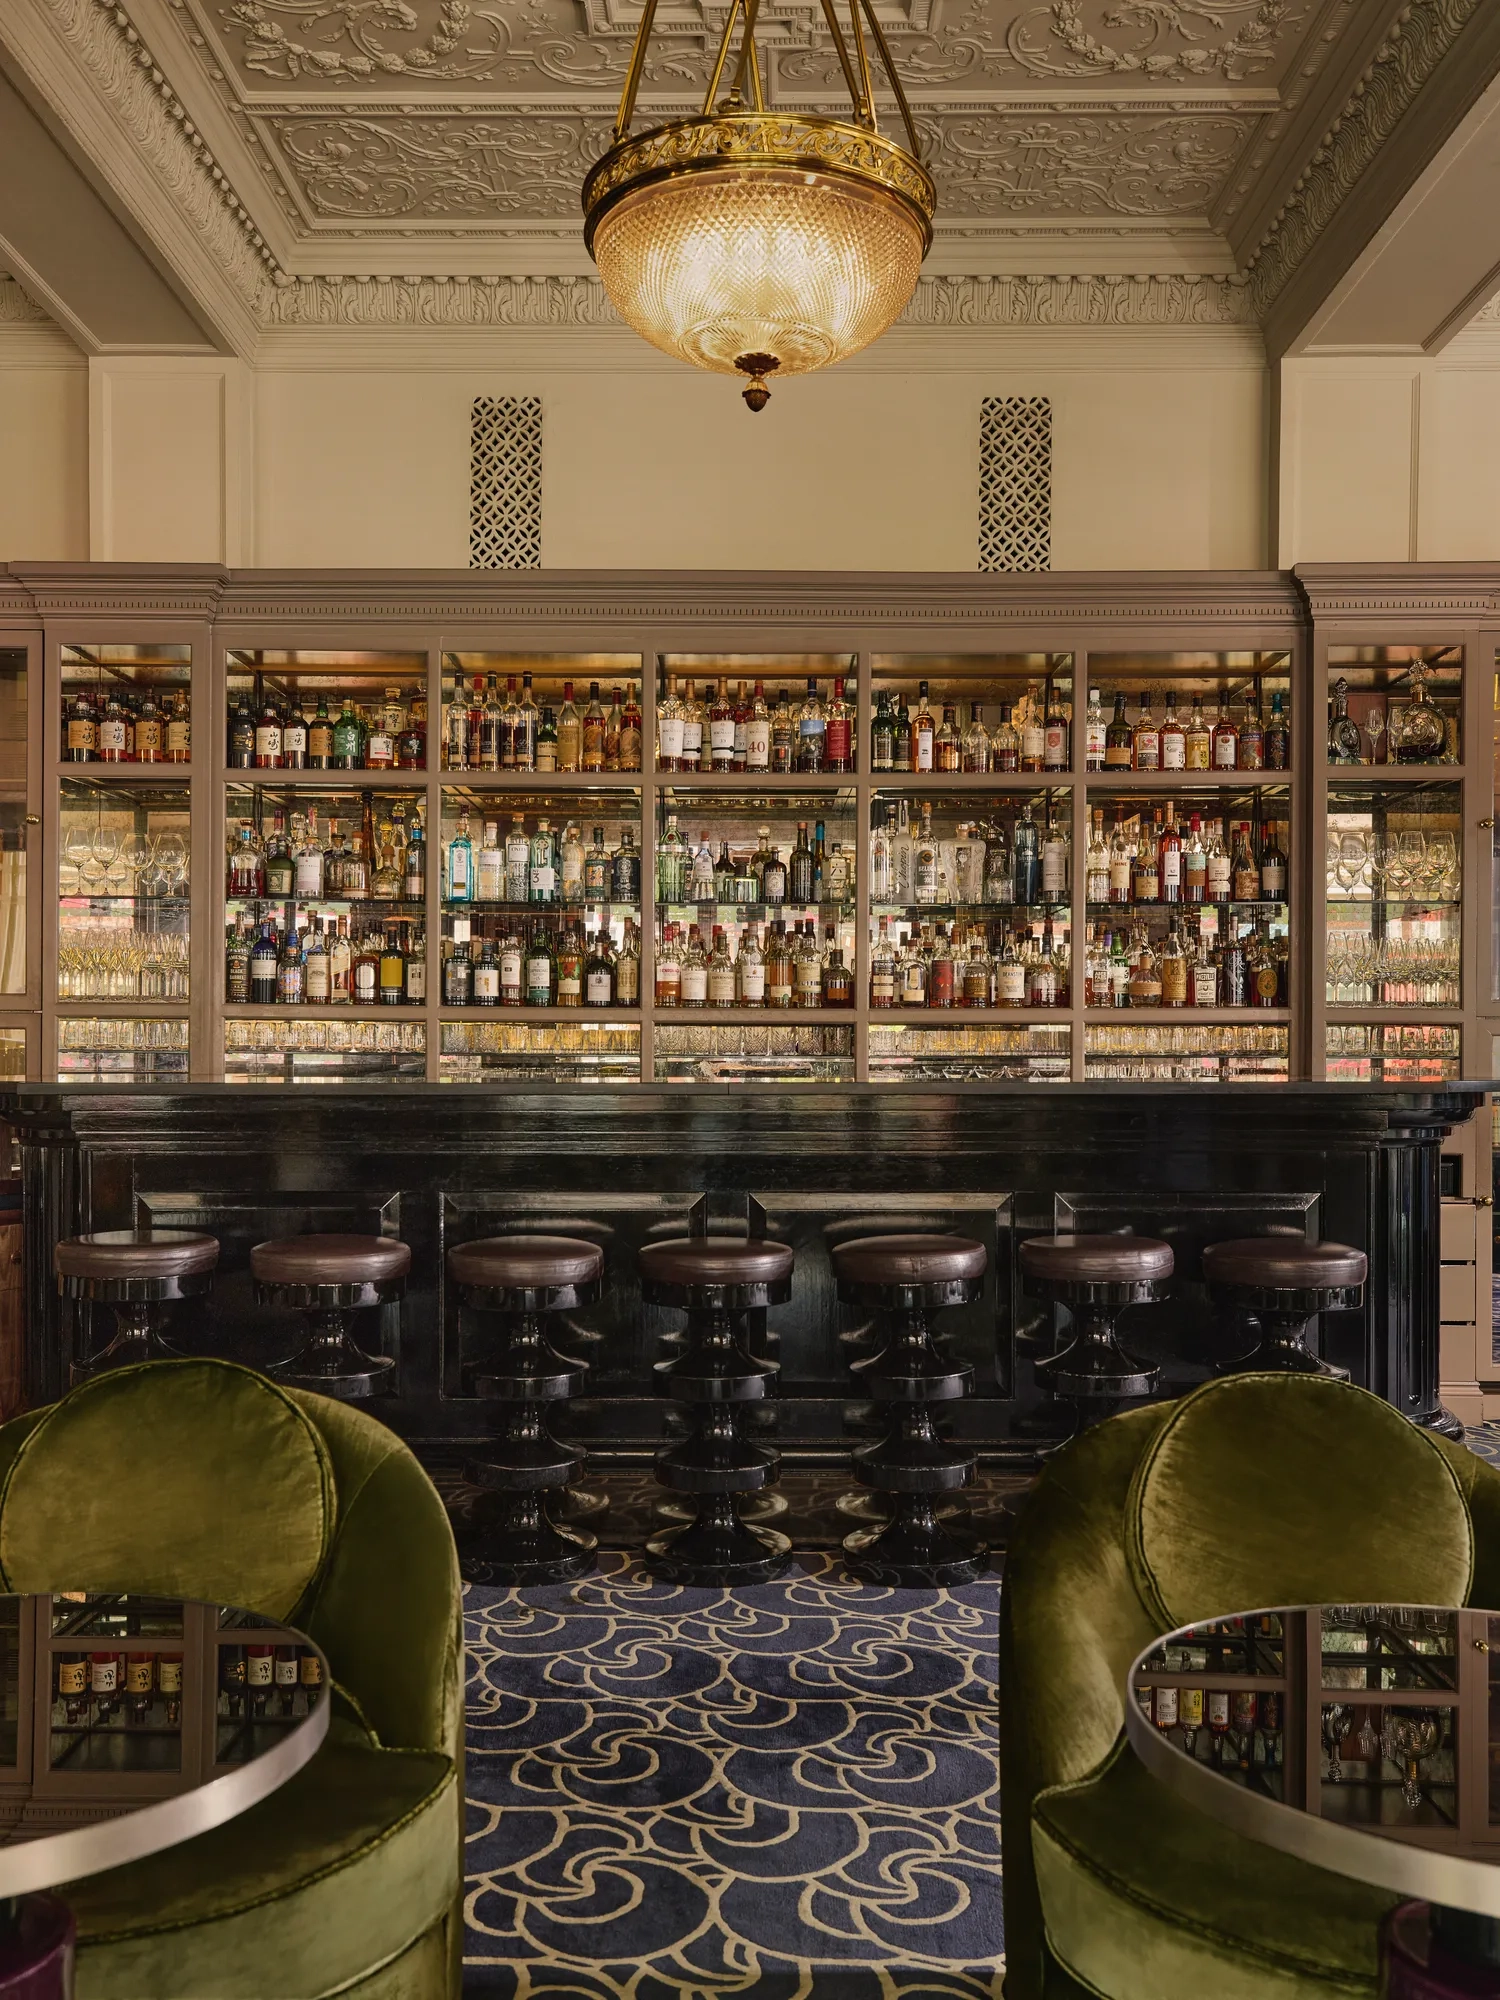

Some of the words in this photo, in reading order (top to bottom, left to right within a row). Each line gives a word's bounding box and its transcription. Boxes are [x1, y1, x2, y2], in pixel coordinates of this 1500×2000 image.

[113, 726, 124, 744] 山崎
[268, 731, 279, 750] 山崎
[345, 730, 356, 753] 白州
[749, 741, 765, 753] 40
[899, 844, 910, 889] Chopin
[532, 873, 540, 884] 3
